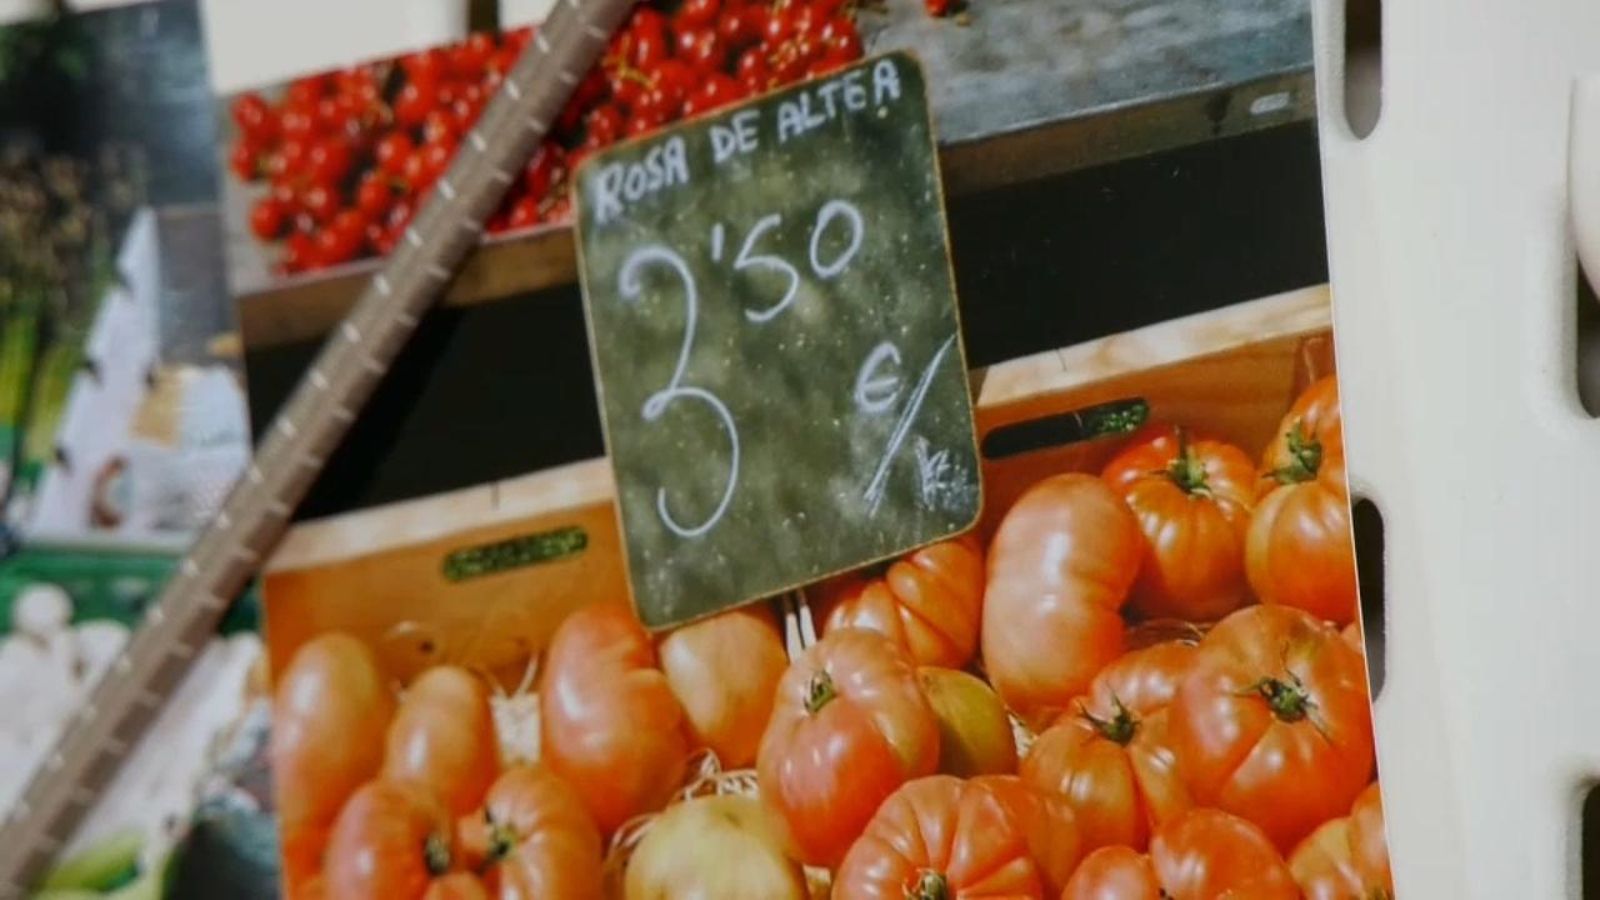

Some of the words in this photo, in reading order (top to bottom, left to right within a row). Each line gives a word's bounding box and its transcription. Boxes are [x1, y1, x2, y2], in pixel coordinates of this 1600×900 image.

[594, 136, 690, 224] ROSA
[709, 109, 760, 164] DE
[777, 58, 901, 143] ALTEA
